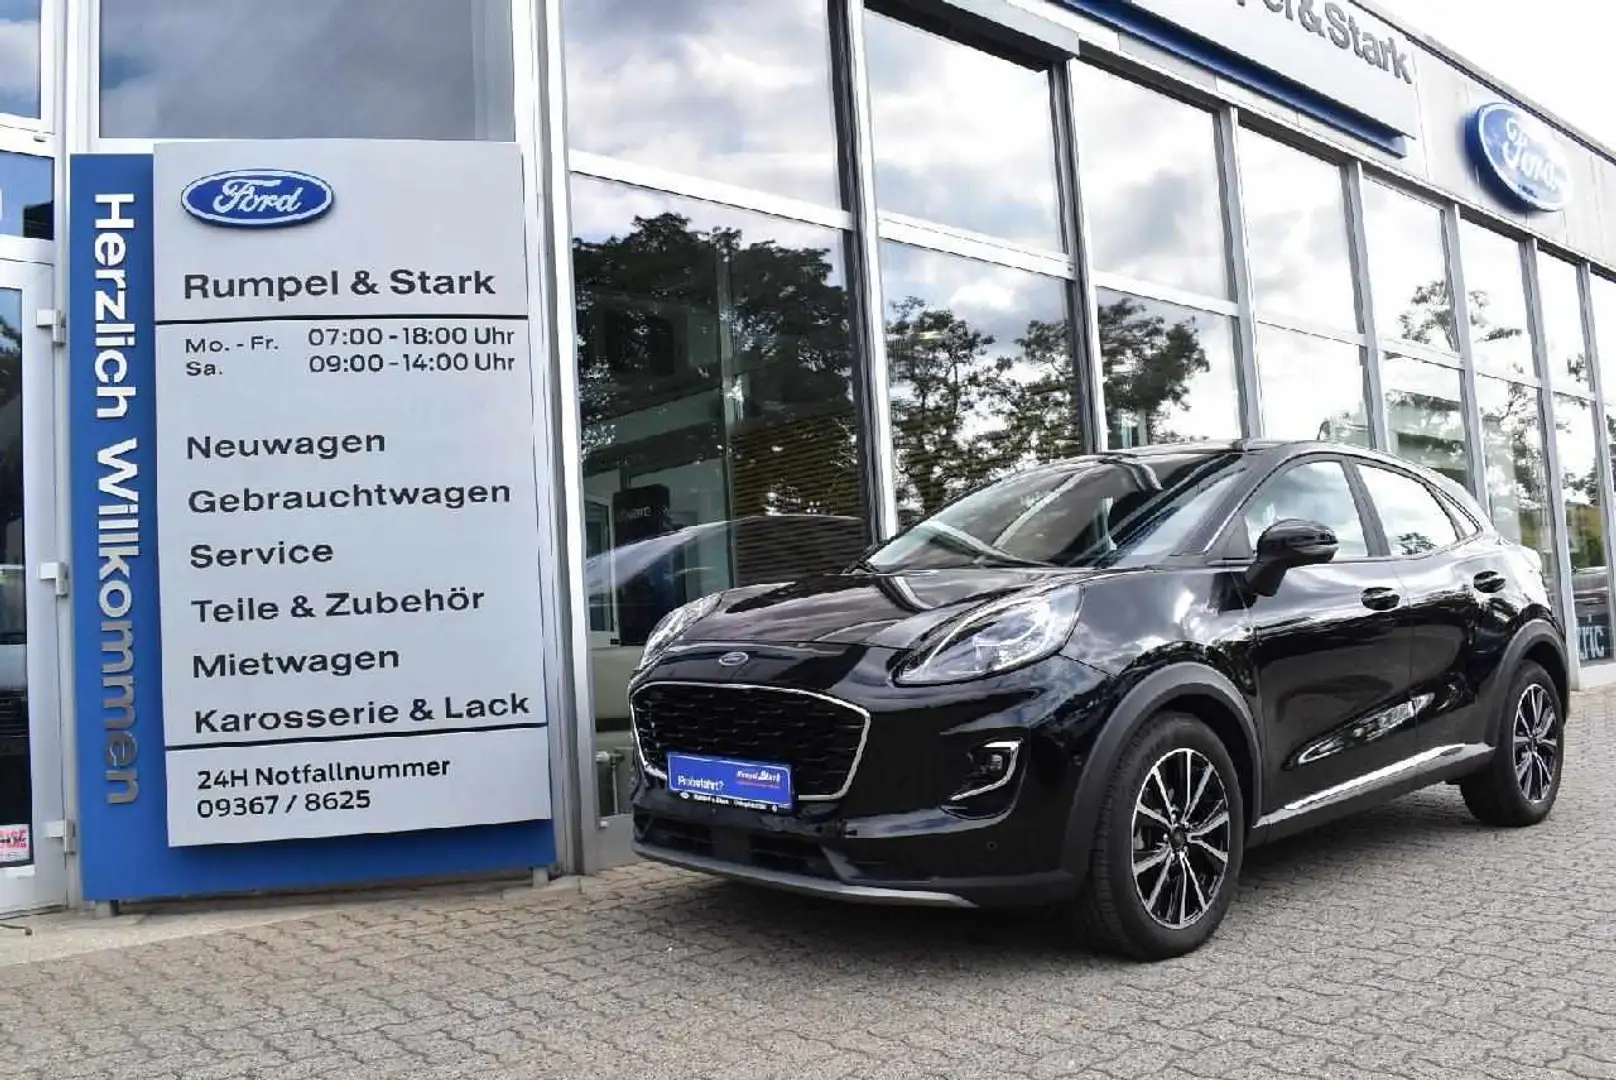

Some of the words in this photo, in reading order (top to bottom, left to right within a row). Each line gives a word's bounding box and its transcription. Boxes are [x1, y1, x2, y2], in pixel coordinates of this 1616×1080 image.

[212, 178, 303, 214] Ford
[184, 270, 339, 302] Rumpel
[350, 269, 380, 296] &
[389, 268, 497, 296] Stark
[94, 193, 138, 419] Herzlich
[185, 338, 230, 354] Mo.
[250, 335, 279, 351] Fr.
[474, 326, 516, 345] Uhr
[185, 360, 223, 377] Sa.
[474, 352, 516, 372] Uhr
[187, 431, 385, 460] Neuwagen
[188, 480, 511, 515] Gebrauchtwagen
[190, 540, 334, 569] Service
[96, 437, 140, 805] Willkommen
[190, 597, 279, 623] Teile
[290, 594, 317, 618] &
[325, 586, 485, 618] Zubehör
[193, 646, 400, 680] Mietwagen
[195, 701, 399, 734] Karosserie
[408, 698, 436, 722] &
[444, 692, 530, 720] Lack
[197, 768, 249, 790] 24H
[255, 758, 451, 786] Notfallnummer
[196, 794, 279, 819] 09367
[284, 794, 298, 814] /
[304, 789, 372, 812] 8625
